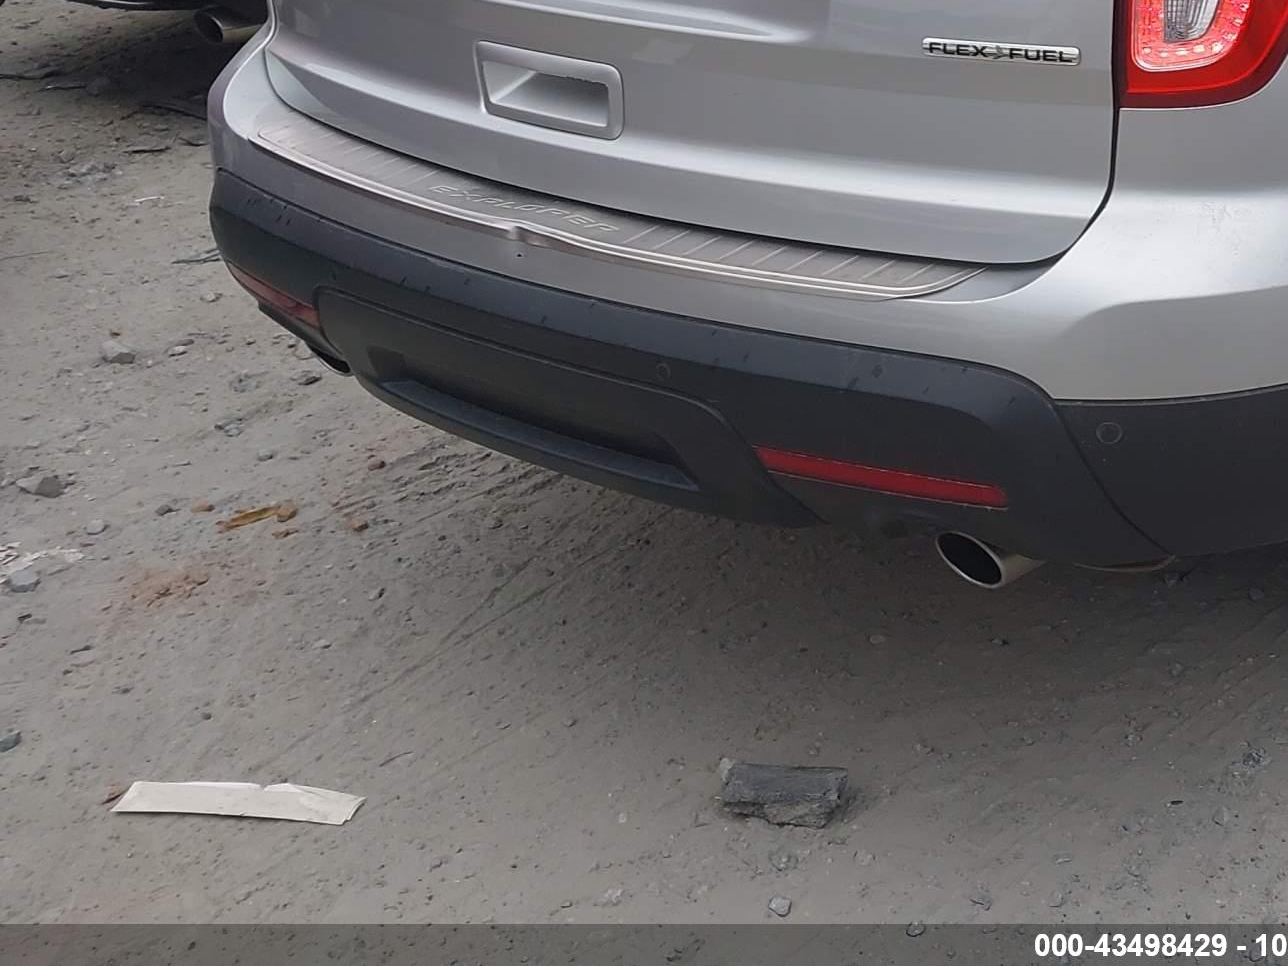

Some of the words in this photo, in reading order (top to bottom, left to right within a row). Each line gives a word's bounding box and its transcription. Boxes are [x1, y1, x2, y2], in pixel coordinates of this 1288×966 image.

[928, 41, 989, 58] FLEX
[1009, 47, 1073, 63] FUEL
[428, 184, 621, 232] EXPLORER
